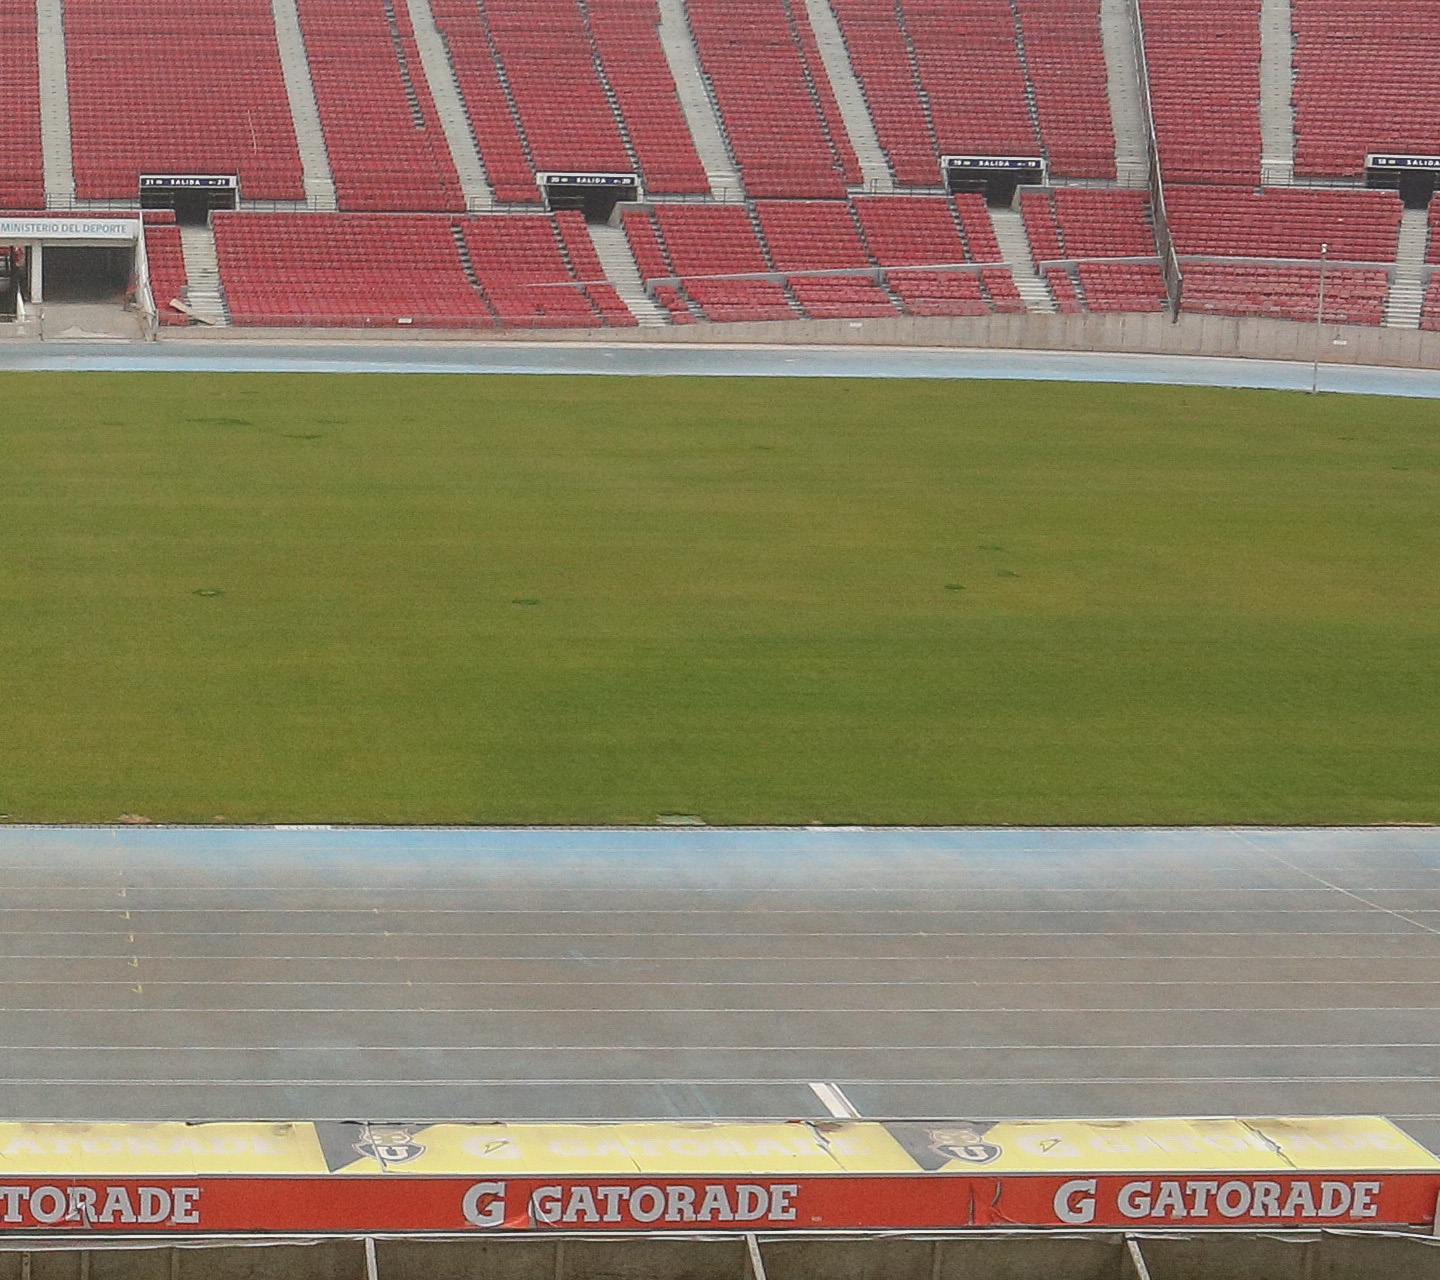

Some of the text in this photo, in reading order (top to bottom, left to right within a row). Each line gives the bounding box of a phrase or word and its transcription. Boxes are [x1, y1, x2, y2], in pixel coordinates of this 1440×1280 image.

[1406, 159, 1440, 167] SALIDA
[0, 222, 128, 234] MINISTERIO DEL DEPORTE
[462, 1181, 799, 1228] G GATORADE
[1053, 1179, 1381, 1224] G GATORADE
